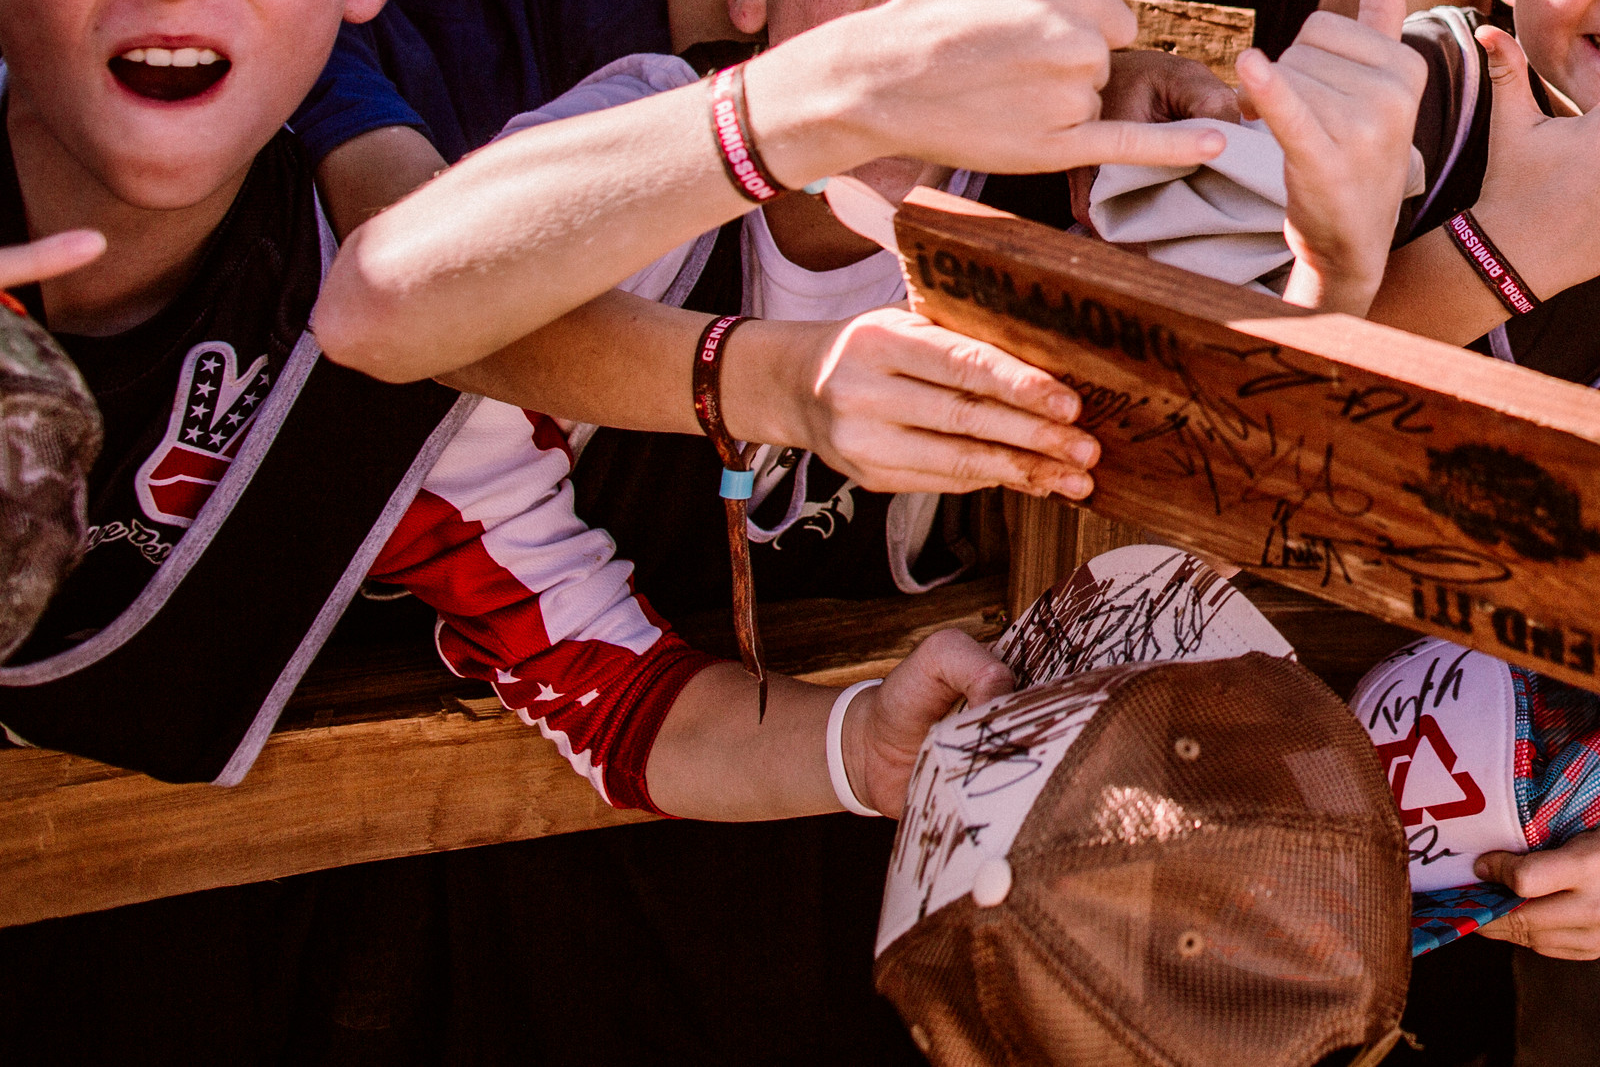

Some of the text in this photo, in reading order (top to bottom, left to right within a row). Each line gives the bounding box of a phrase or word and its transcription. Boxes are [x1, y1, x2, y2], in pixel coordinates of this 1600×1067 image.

[714, 99, 776, 200] ADMISSION
[1451, 214, 1504, 278] ADMISSION
[1411, 575, 1473, 634] IT!
